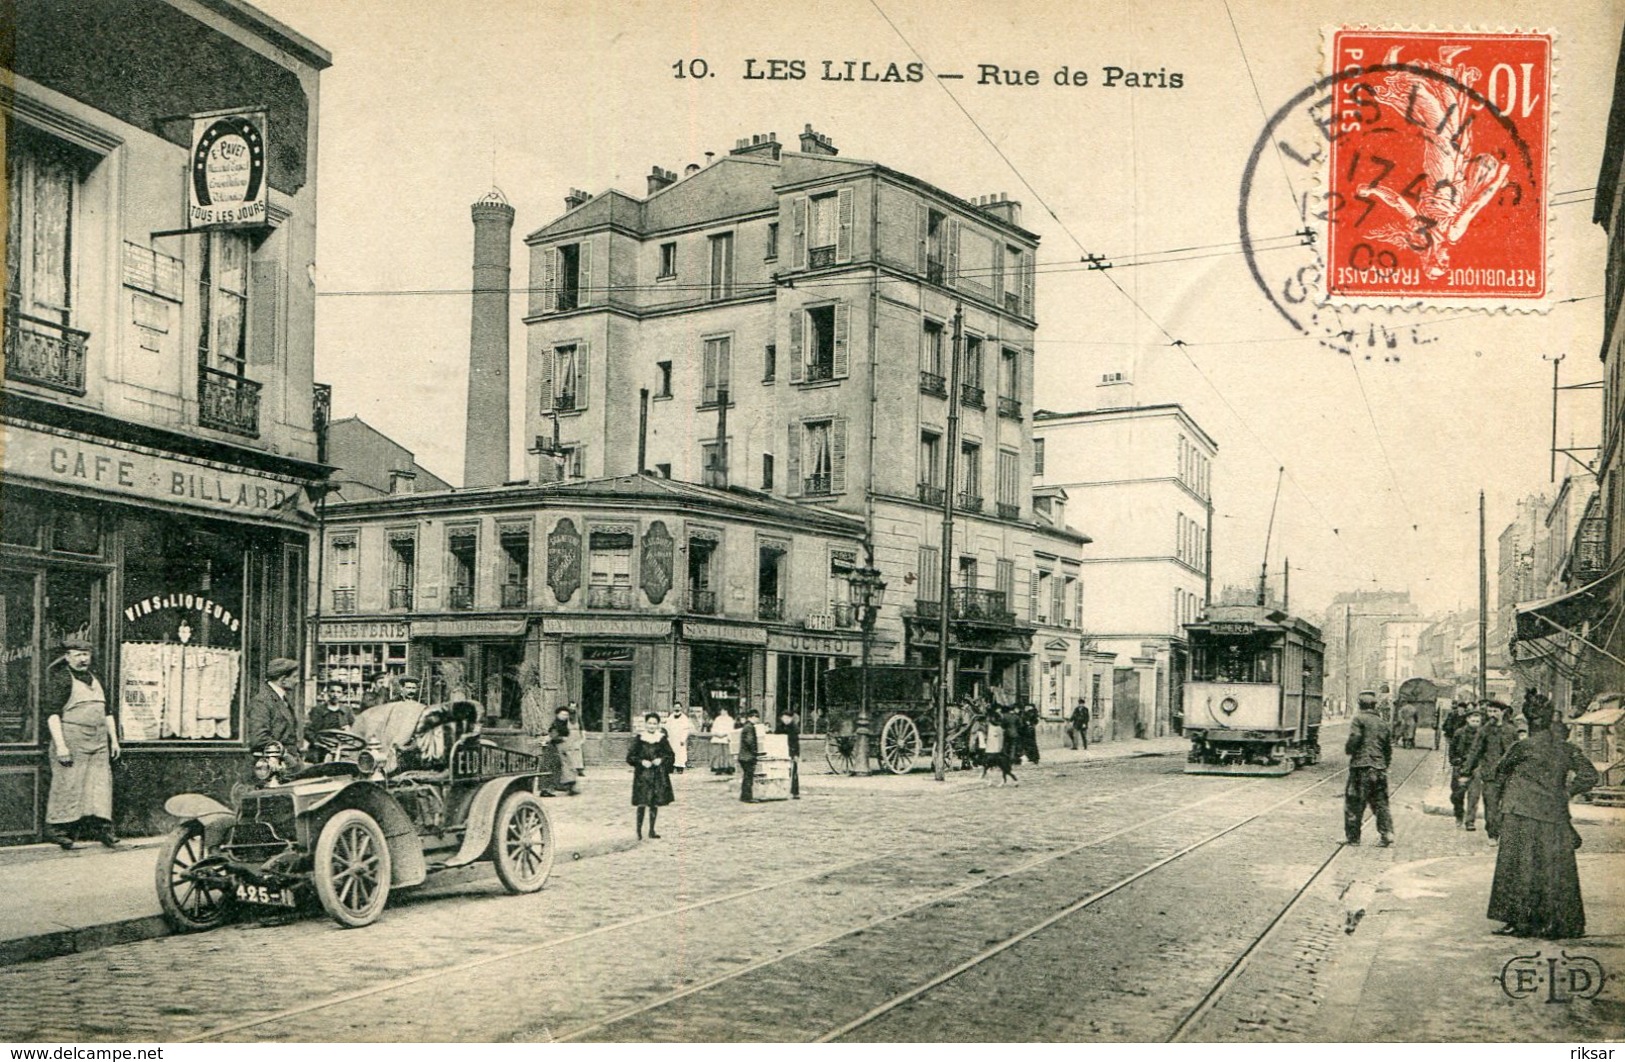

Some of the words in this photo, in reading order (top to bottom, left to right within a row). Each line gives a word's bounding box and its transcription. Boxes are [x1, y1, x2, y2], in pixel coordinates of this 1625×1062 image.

[1341, 47, 1364, 132] POSTES
[1488, 62, 1540, 118] 10
[191, 205, 213, 222] TOUS
[216, 210, 234, 222] LES
[237, 200, 265, 220] JOURS
[1337, 265, 1420, 286] FRANÇAISE
[1446, 266, 1536, 288] REPUBLIQUE
[170, 470, 287, 510] BILLARD
[124, 595, 162, 622] VINS
[170, 593, 240, 632] LIQUEURS
[791, 636, 851, 653] OCTROI
